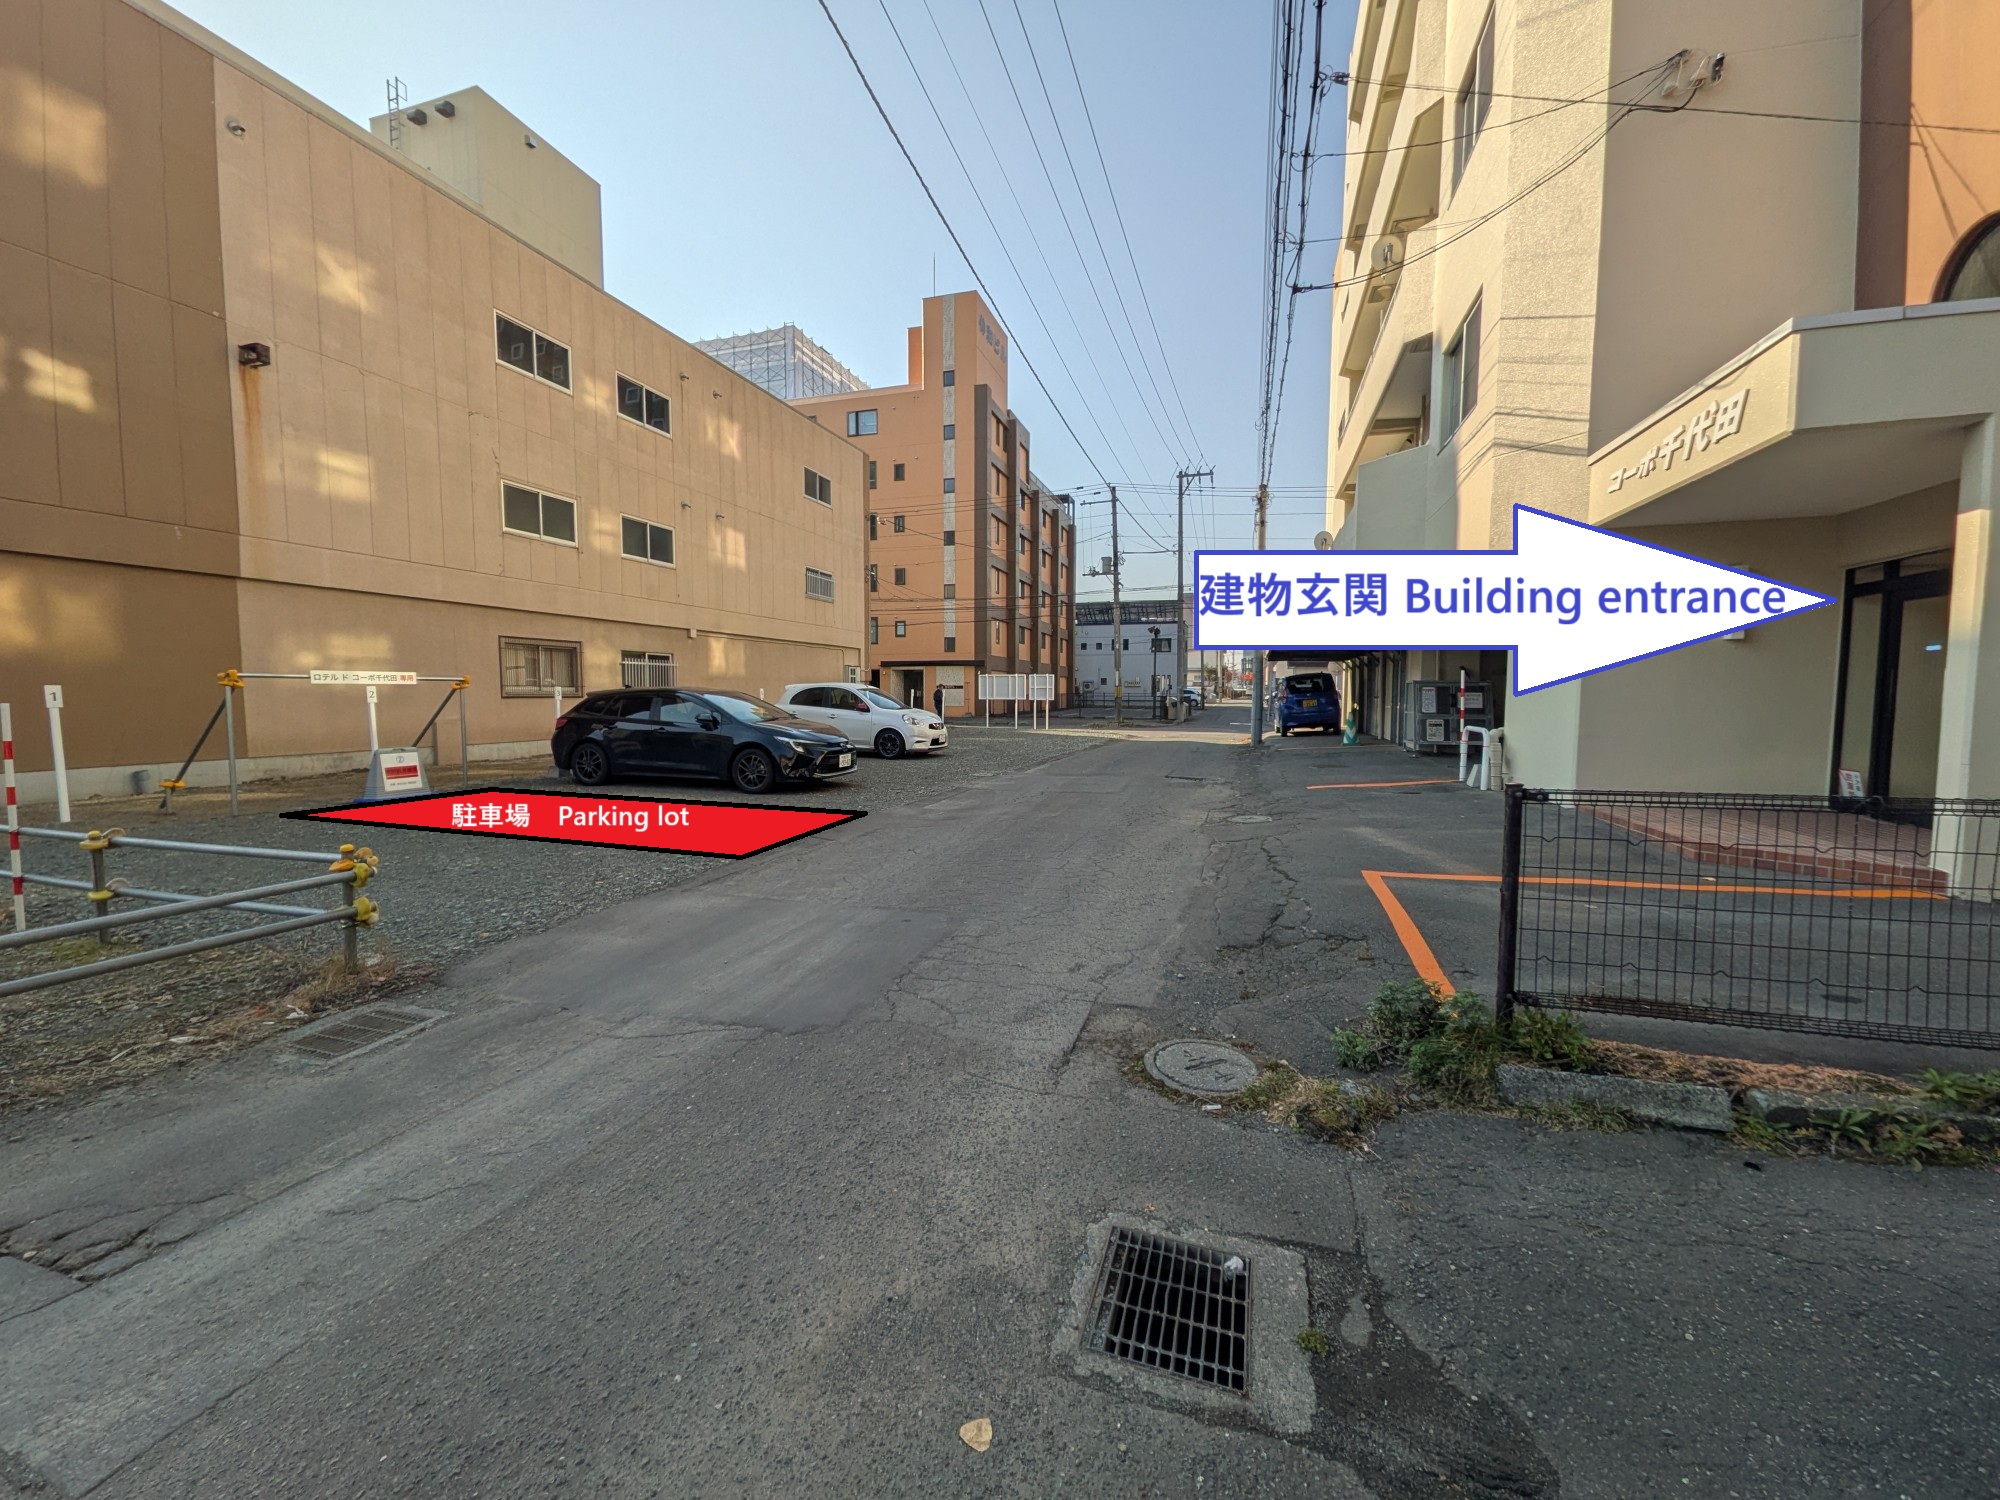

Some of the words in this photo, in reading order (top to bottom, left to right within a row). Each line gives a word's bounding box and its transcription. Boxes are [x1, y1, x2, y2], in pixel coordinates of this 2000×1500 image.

[1608, 388, 1750, 494] コーポ千代田
[313, 673, 340, 682] ロテル
[49, 692, 56, 701] 1
[369, 690, 375, 699] 2
